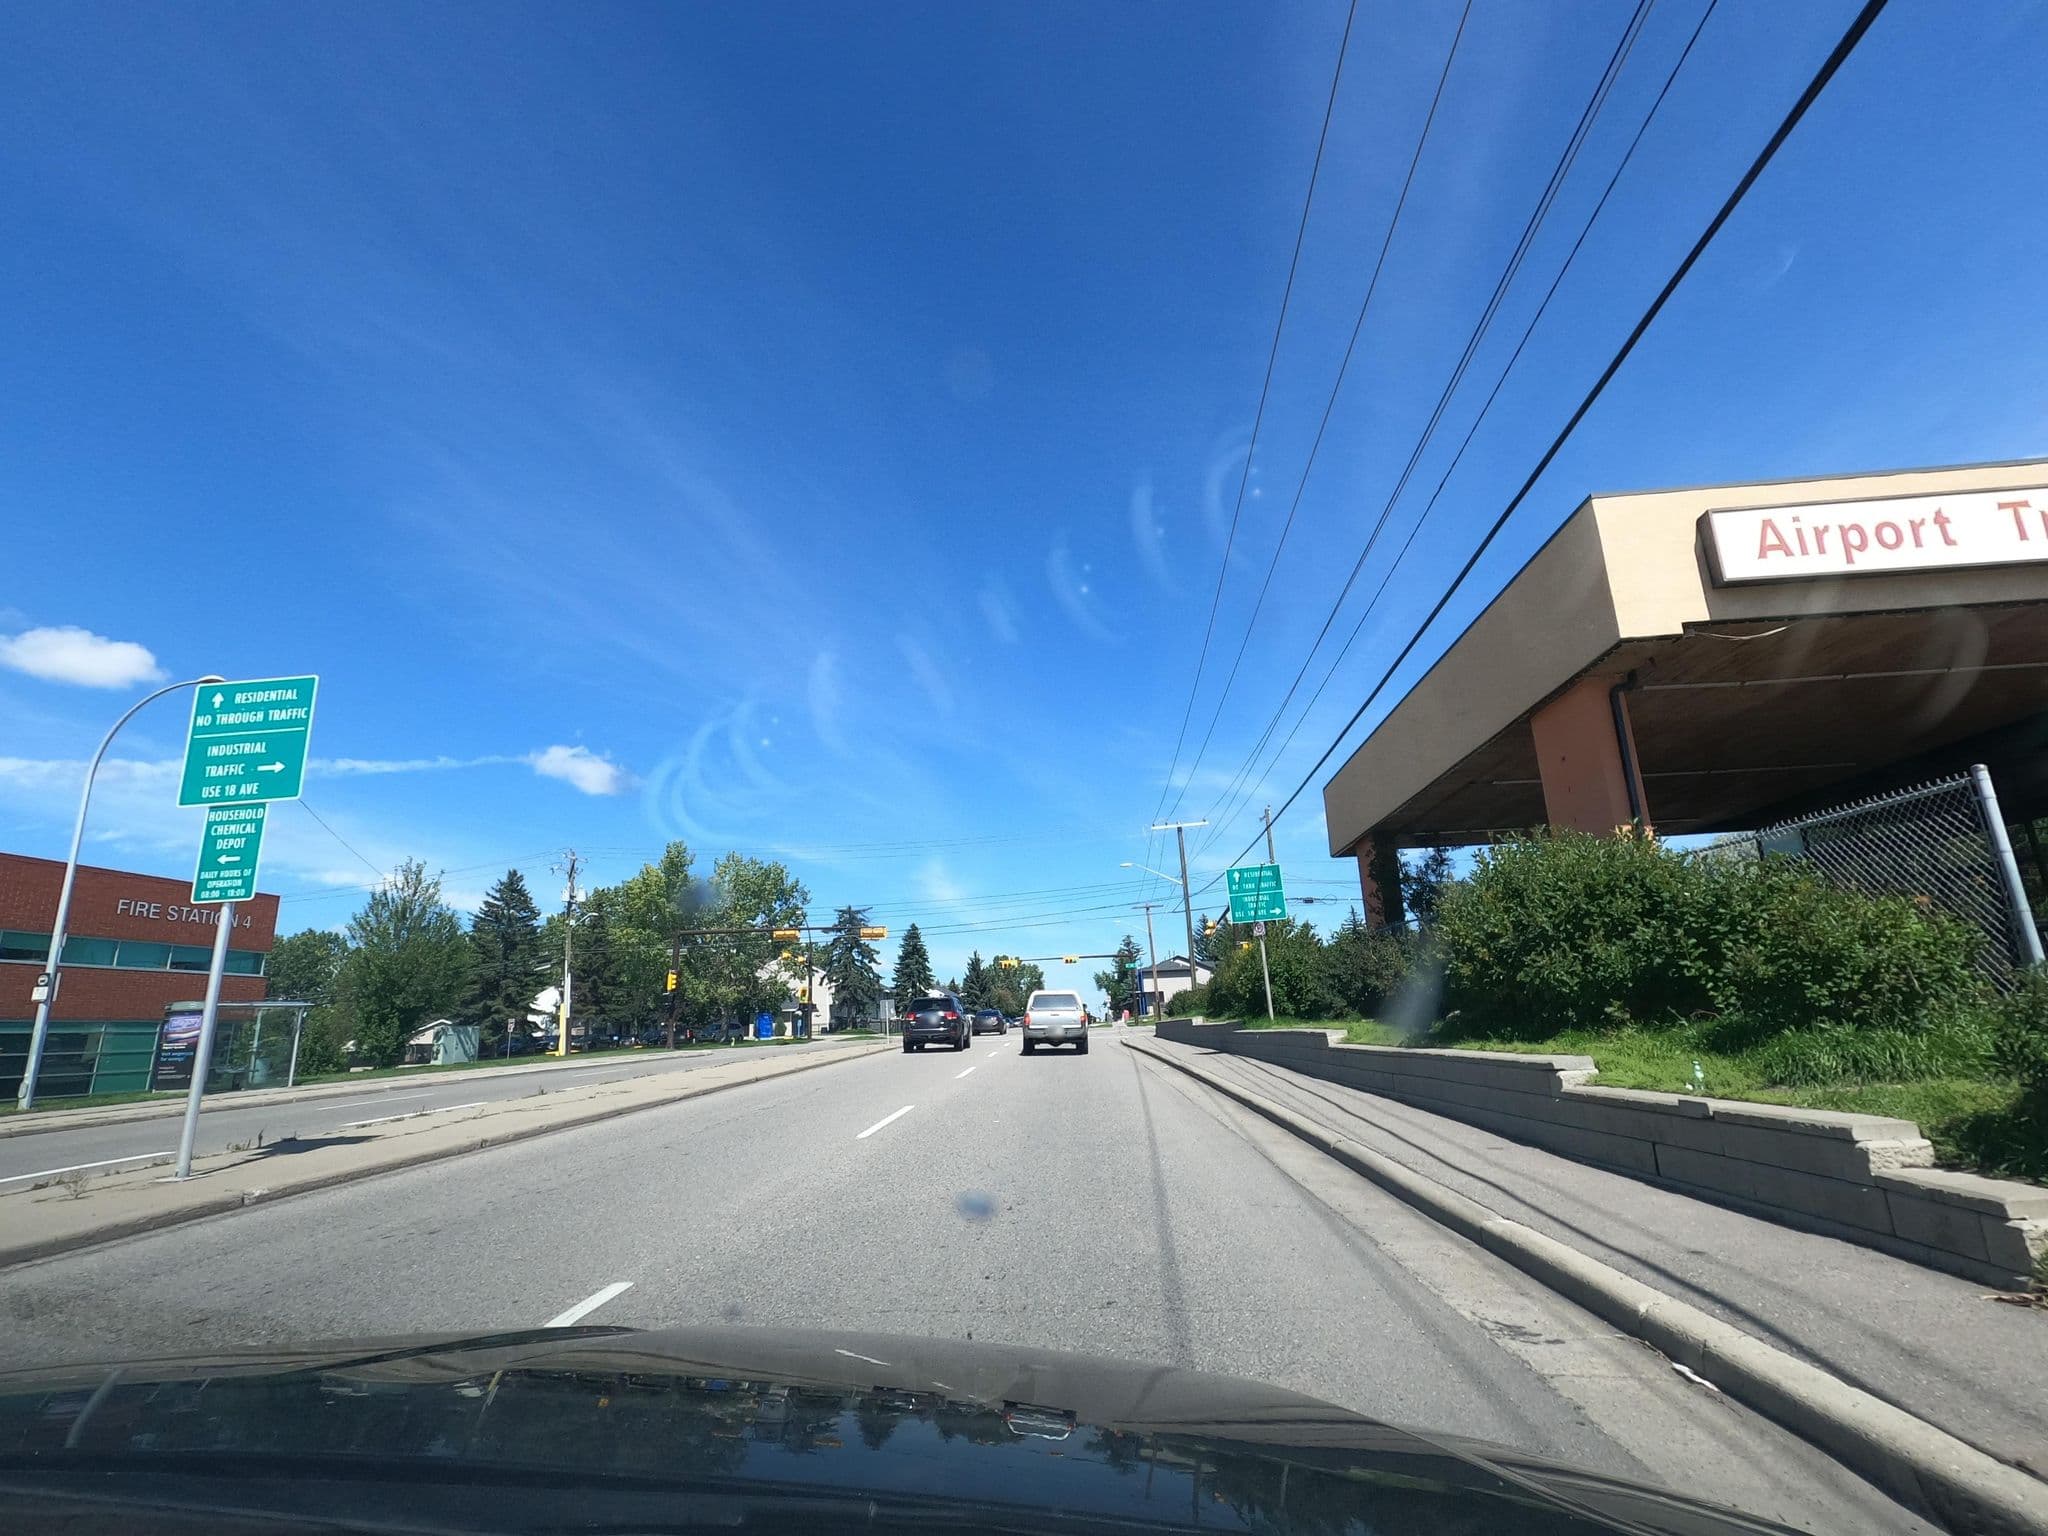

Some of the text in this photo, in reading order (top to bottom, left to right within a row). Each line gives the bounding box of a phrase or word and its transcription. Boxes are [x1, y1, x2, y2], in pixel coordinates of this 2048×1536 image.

[1757, 507, 1958, 565] Airport
[234, 689, 298, 704] RESIDENTIAL
[196, 707, 308, 727] NO THROUGH TRAFFIC
[207, 741, 267, 757] INDUSTRIAL
[205, 763, 245, 778] TRAFFIC
[201, 782, 260, 798] USE 18 AVE
[208, 808, 264, 822] HOUSEHOLD
[211, 823, 256, 836] CHEMICAL
[216, 837, 247, 850] DEPOT
[219, 869, 242, 878] HOURS
[116, 899, 162, 919] FIRE
[242, 916, 252, 929] 4
